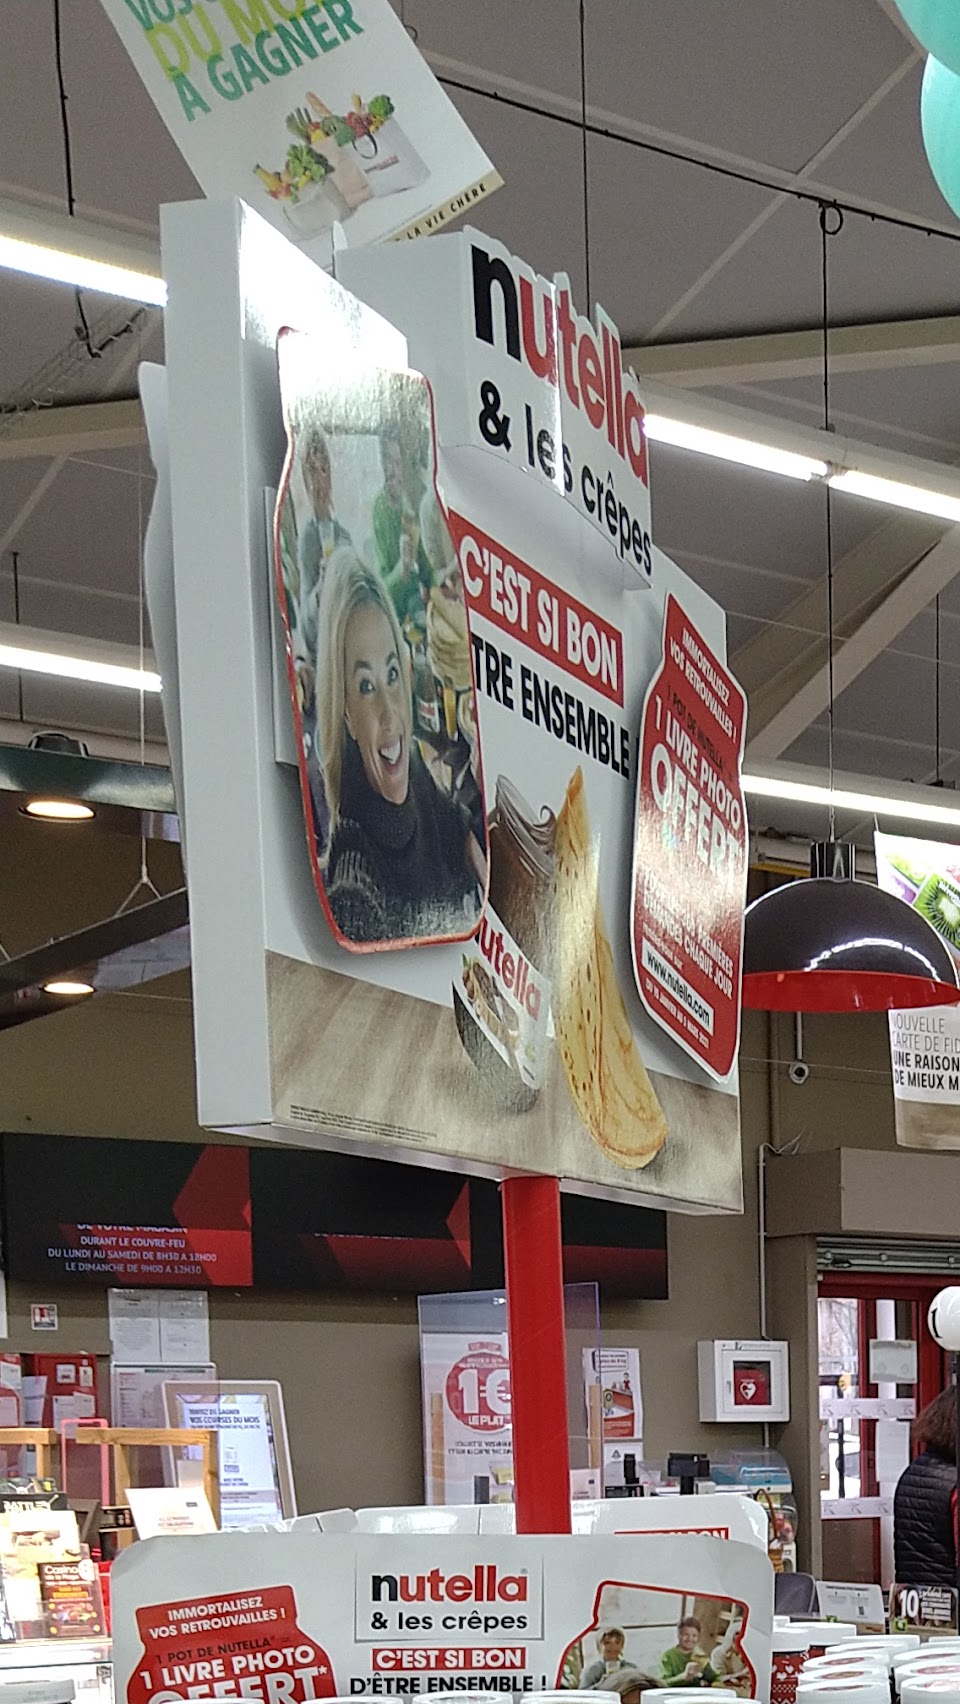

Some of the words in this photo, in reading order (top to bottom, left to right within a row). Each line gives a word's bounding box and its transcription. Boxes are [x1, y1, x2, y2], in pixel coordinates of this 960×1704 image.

[145, 3, 223, 81] DU
[168, 66, 212, 122] À
[207, 0, 364, 100] GAGNER
[426, 210, 446, 229] VIE
[471, 244, 648, 488] nutella
[479, 380, 511, 453] &
[525, 403, 573, 492] les
[582, 464, 651, 577] crêpes
[459, 536, 531, 633] C'EST
[537, 589, 559, 653] SI
[567, 612, 618, 691] BON
[682, 627, 730, 707] IMMORTALISEZ
[670, 637, 684, 671] VOS
[685, 658, 732, 737] RETROUVAILLES
[520, 664, 630, 781] ENSEMBLE
[656, 695, 662, 731] 1
[666, 710, 698, 779] LIVRE
[701, 757, 741, 831] PHOTO
[684, 935, 713, 981] CHAQUE
[714, 966, 733, 1001] JOUR
[924, 1035, 940, 1053] DE
[893, 1050, 911, 1068] UNE
[914, 1053, 960, 1073] RAISON
[895, 1068, 905, 1086] DE
[907, 1071, 945, 1090] MIEUX
[47, 1248, 62, 1259] DU
[63, 1248, 91, 1260] LUNDI
[92, 1250, 106, 1260] AU
[106, 1250, 141, 1261] SAMEDI
[142, 1251, 154, 1261] DE
[180, 1252, 187, 1262] A
[80, 1236, 117, 1247] DURANT
[118, 1237, 129, 1247] LE
[131, 1237, 186, 1249] COUVRE-FEU
[65, 1261, 77, 1272] LE
[78, 1262, 125, 1273] DIMANCHE
[126, 1263, 139, 1273] DE
[164, 1264, 172, 1274] A
[371, 1565, 528, 1602] nutella
[167, 1596, 263, 1621] IMMORTALISEZ
[371, 1612, 389, 1629] &
[398, 1612, 433, 1629] les
[442, 1610, 528, 1633] crêpes
[149, 1626, 177, 1639] VOS
[181, 1612, 278, 1634] RETROUVAILLES
[167, 1650, 193, 1663] POT
[196, 1647, 214, 1658] DE
[217, 1638, 271, 1654] NUTELLA
[376, 1650, 439, 1669] C'EST
[444, 1650, 464, 1668] SI
[471, 1649, 521, 1667] BON
[139, 1670, 153, 1690] 1
[161, 1658, 226, 1687] LIVRE
[231, 1645, 316, 1675] PHOTO
[427, 1675, 533, 1692] ENSEMBLE
